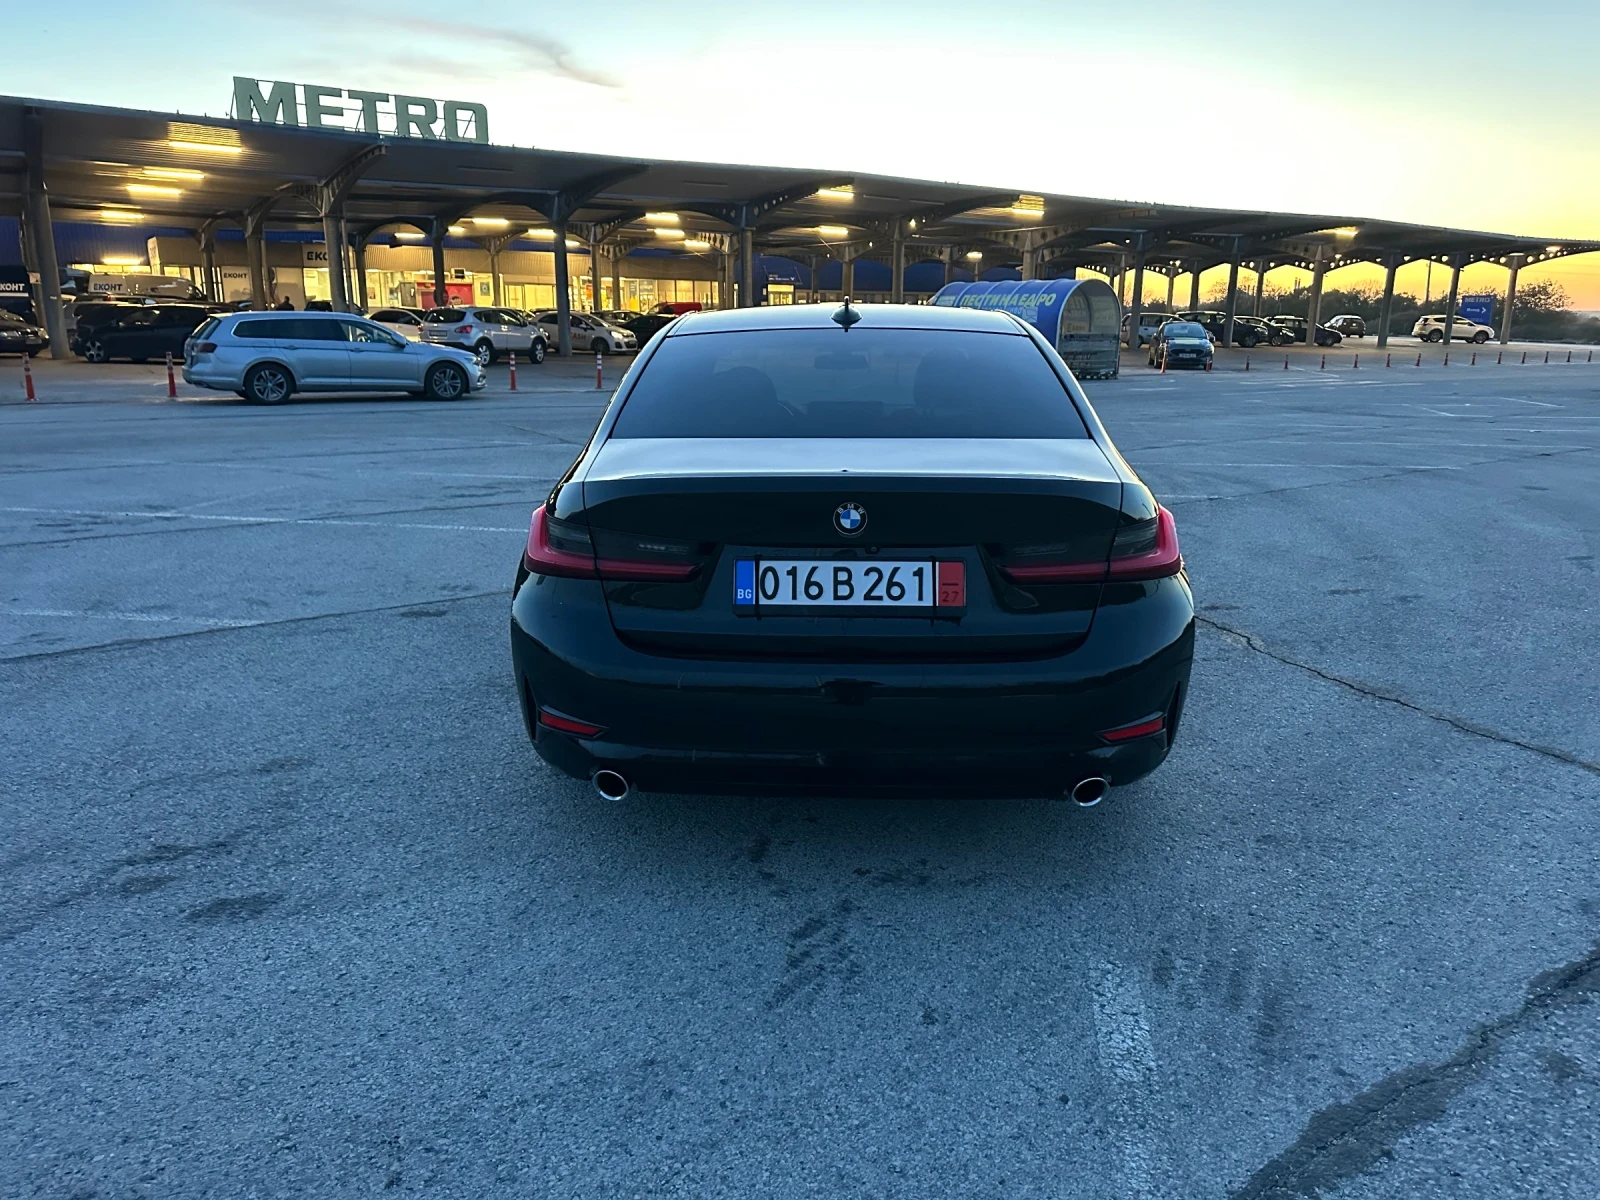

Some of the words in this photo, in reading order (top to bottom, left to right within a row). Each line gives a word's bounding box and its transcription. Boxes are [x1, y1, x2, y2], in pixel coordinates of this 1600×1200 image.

[233, 76, 489, 144] METRO
[0, 283, 25, 291] КОНТ
[93, 283, 123, 291] ЕКОНТ
[837, 503, 865, 514] BMW
[737, 589, 752, 599] BG
[942, 592, 959, 602] 27
